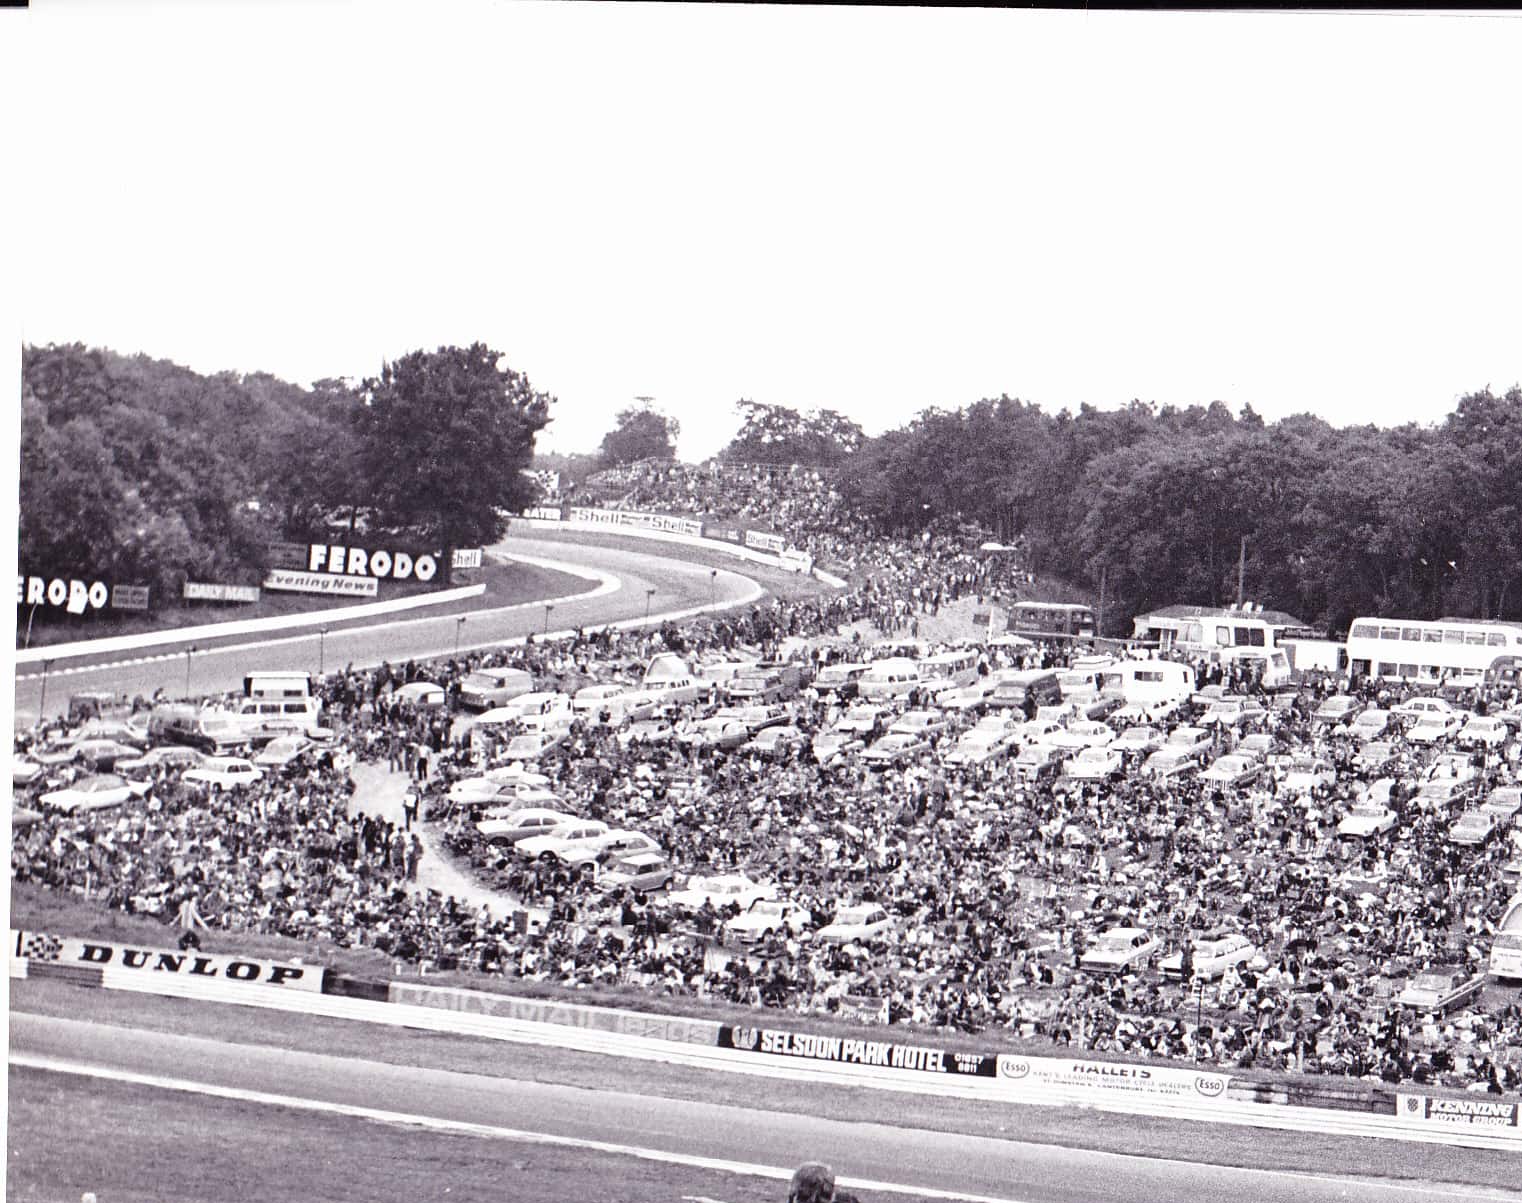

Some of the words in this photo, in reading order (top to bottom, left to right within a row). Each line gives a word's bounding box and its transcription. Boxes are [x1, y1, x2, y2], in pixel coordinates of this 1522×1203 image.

[579, 509, 620, 526] Shell
[309, 543, 437, 582] FERODO
[78, 944, 306, 985] DUNLOP
[760, 1029, 842, 1061] SELSDON
[843, 1039, 893, 1065] PARK
[893, 1046, 948, 1072] HOTEL
[1429, 1099, 1514, 1117] KENNING
[1430, 1112, 1470, 1124] MOTOR
[1472, 1115, 1513, 1127] GROUP
